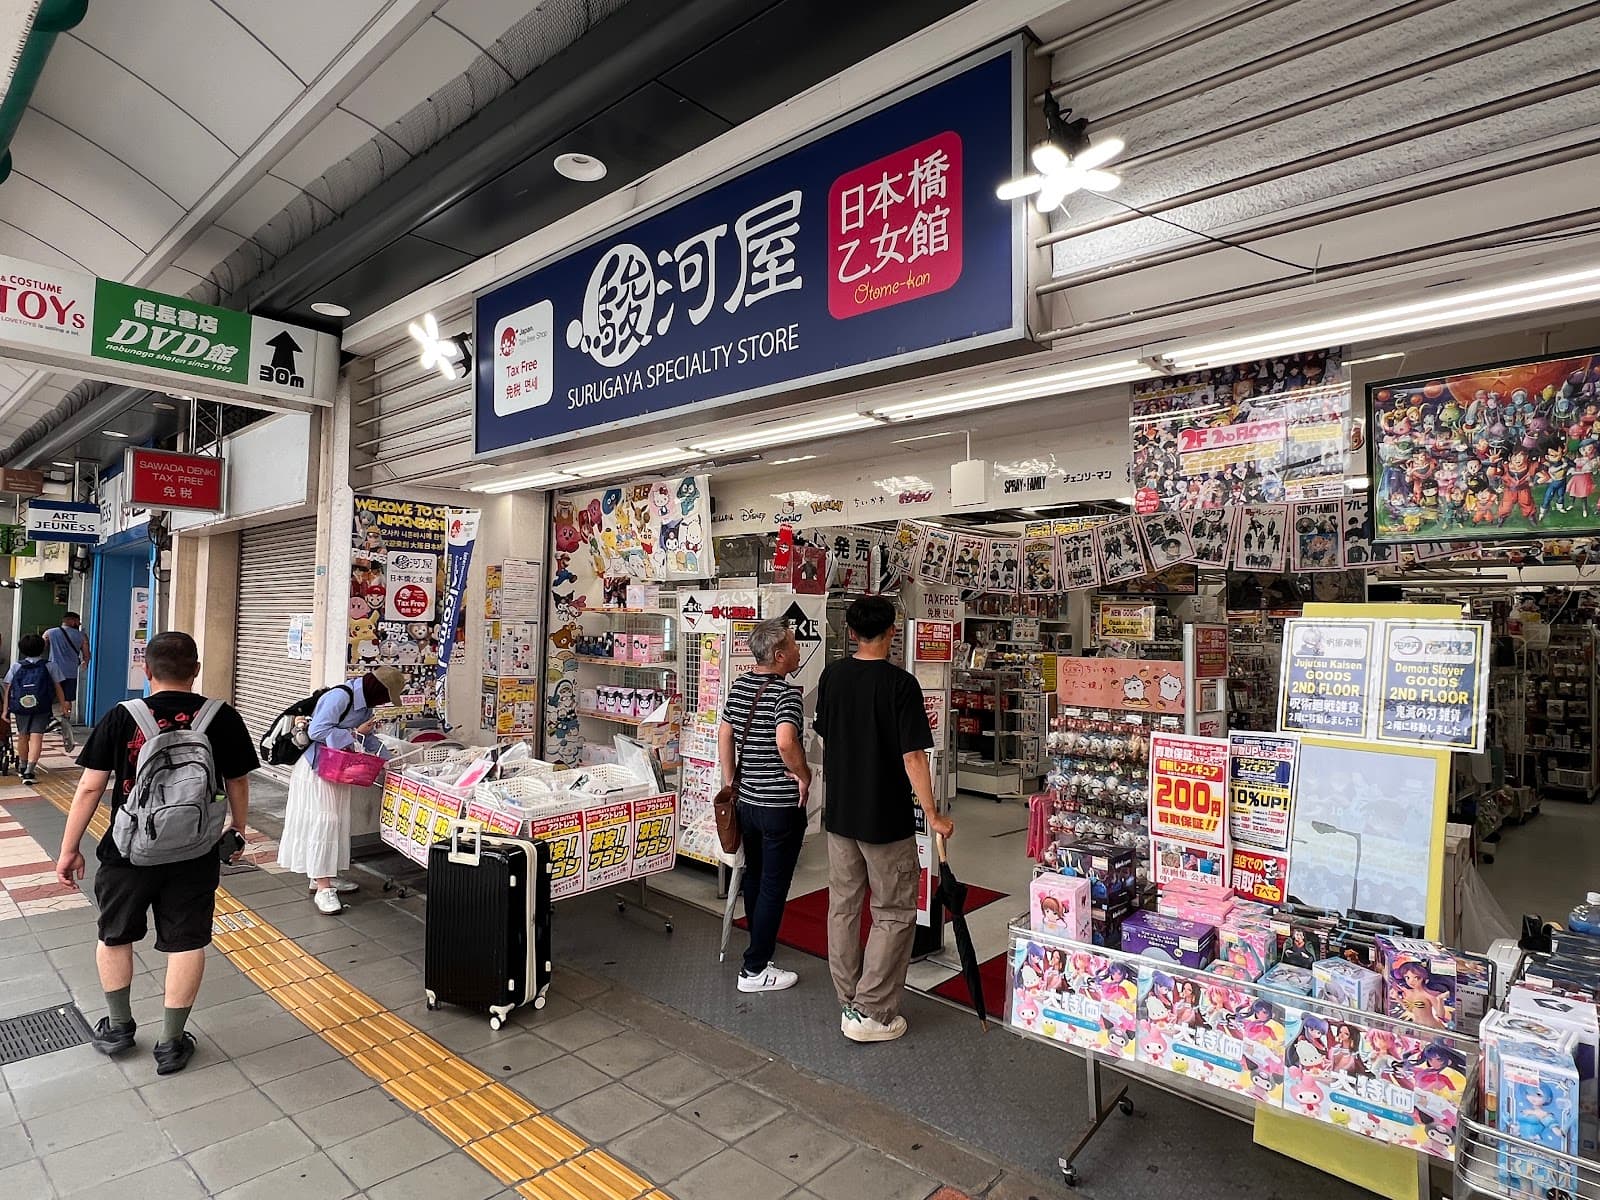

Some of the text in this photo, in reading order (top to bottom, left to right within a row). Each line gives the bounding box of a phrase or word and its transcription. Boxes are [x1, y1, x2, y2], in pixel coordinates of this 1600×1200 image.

[840, 149, 950, 235] 日本橋
[837, 205, 950, 283] 乙女館
[10, 275, 63, 295] COSTUME
[566, 190, 803, 367] 駿河屋
[854, 270, 931, 304] Otome-kan
[134, 299, 219, 334] 信長書店
[106, 318, 239, 365] DVD館
[105, 343, 233, 374] nobunaga shoten since 1992
[567, 323, 800, 410] SURUGAYA SPECIALTY STORE
[259, 364, 304, 388] 30m
[506, 359, 538, 378] Tax Free
[1181, 428, 1208, 450] 2F
[1236, 421, 1281, 441] FLOOR
[139, 460, 216, 477] SAWADA DENKI
[1063, 470, 1112, 484] チェンソーマン
[152, 472, 204, 486] TAX FREE
[53, 512, 78, 521] ART
[354, 498, 413, 515] WELCOME
[415, 504, 432, 517] TO
[34, 521, 95, 532] JEUNESS
[834, 536, 870, 561] 発売
[397, 599, 426, 608] Tax Free
[924, 593, 959, 606] TAXFREE
[1110, 608, 1122, 617] NEW
[1294, 658, 1362, 670] Jujutsu Kaisen
[1395, 663, 1465, 677] Demon Slayer
[1305, 670, 1351, 681] GOODS
[1405, 675, 1459, 688] GOODS
[1291, 682, 1360, 697] 2ND FLOOR
[1390, 687, 1469, 705] 2ND FLOOR
[1157, 776, 1221, 817] 200円
[1231, 788, 1288, 811] 10%UP!
[633, 836, 673, 859] ワゴン
[587, 845, 630, 872] ワゴン
[1255, 886, 1279, 899] すべて
